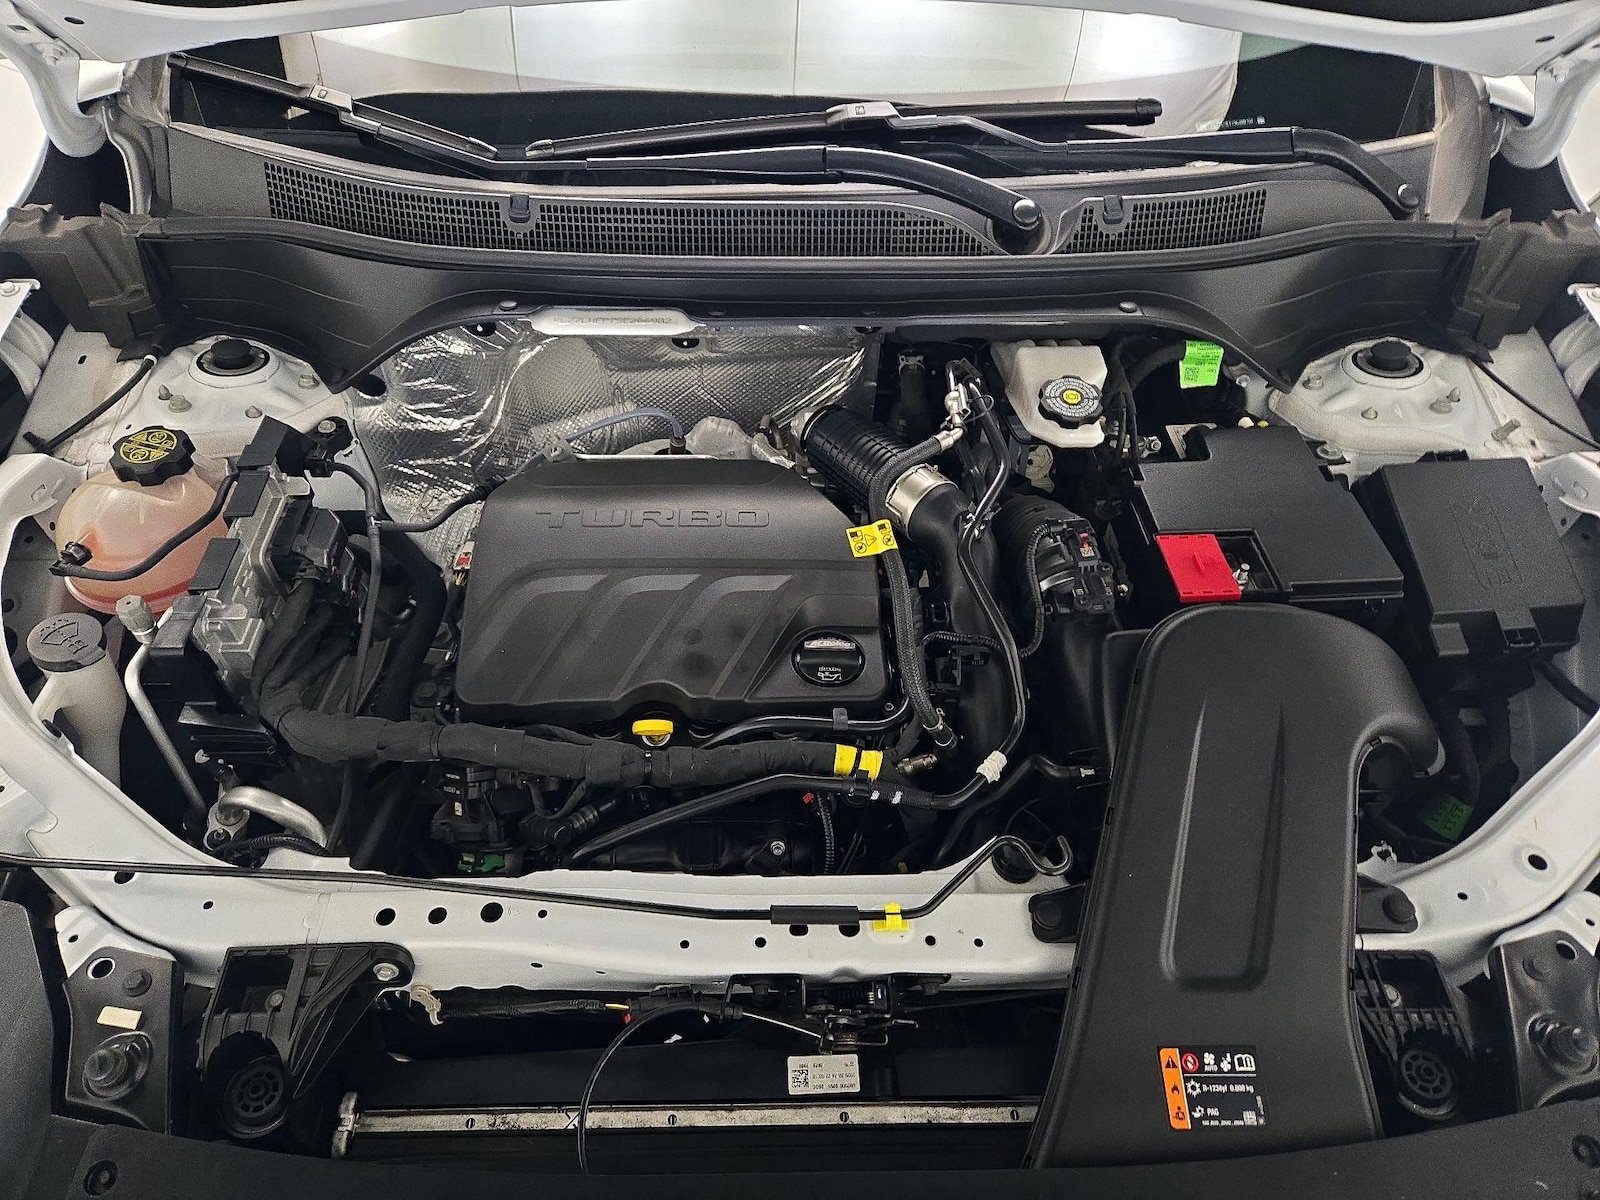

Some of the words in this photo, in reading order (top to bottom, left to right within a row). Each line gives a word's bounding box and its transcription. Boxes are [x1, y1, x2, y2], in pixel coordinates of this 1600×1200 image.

[536, 509, 770, 528] TURBO
[1204, 1064, 1218, 1072] AUTO
[1206, 1107, 1220, 1116] PAG
